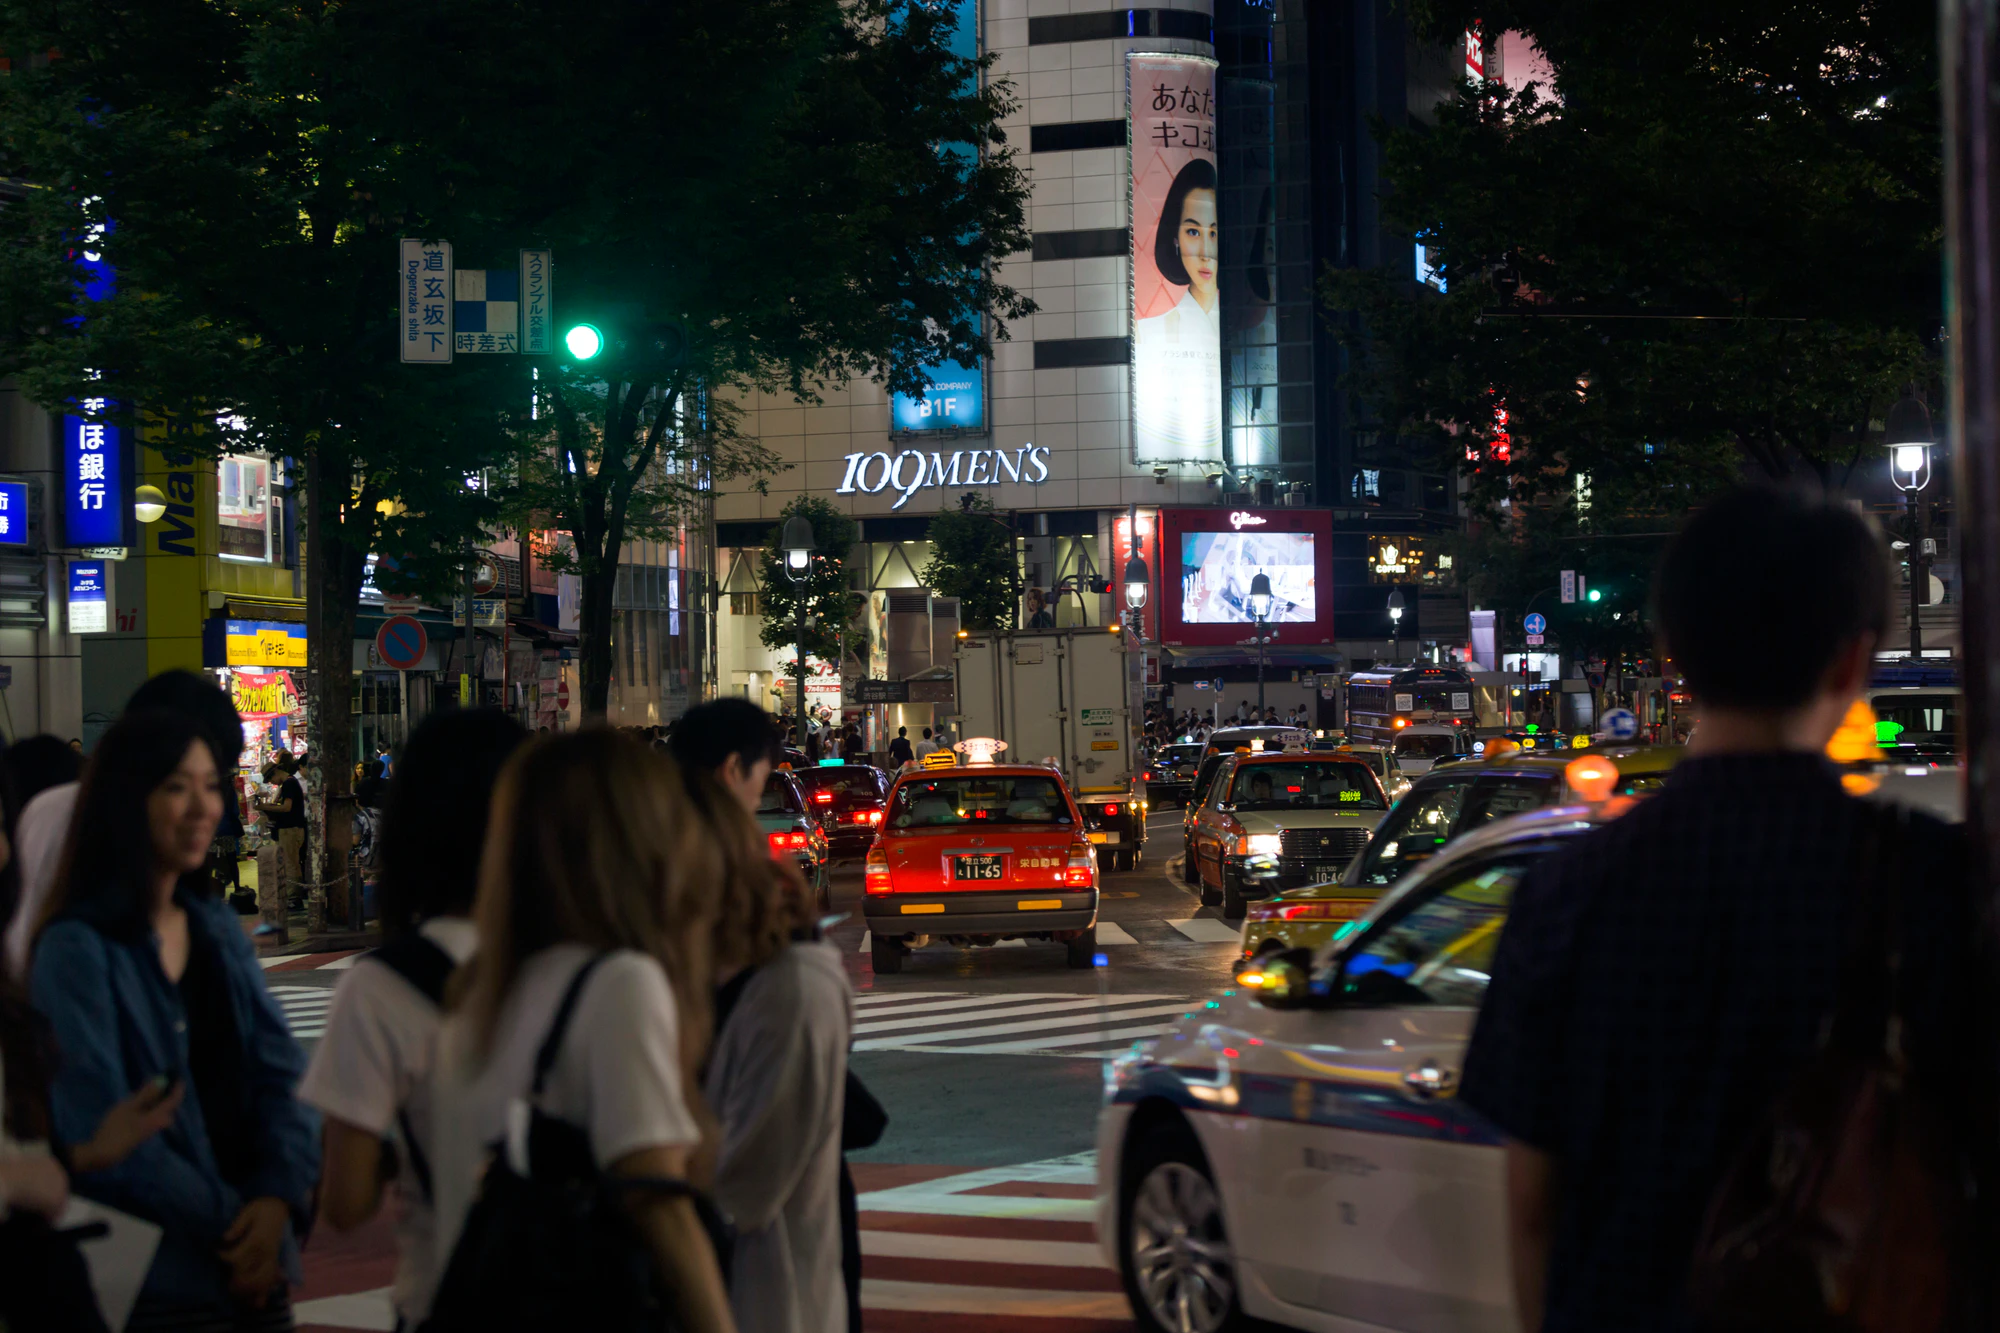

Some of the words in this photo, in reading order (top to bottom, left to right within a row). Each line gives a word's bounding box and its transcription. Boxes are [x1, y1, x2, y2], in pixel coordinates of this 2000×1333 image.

[1152, 83, 1215, 117] あなた
[406, 260, 420, 314] Dogenzaka
[422, 250, 446, 353] 道玄坂下
[529, 253, 545, 349] スクランブル交差点
[408, 318, 420, 342] shita
[457, 333, 516, 352] 時差式
[935, 381, 973, 392] COMPANY
[919, 397, 957, 418] B1F
[1375, 564, 1407, 574] COFFEE
[969, 741, 994, 751] チェッカー
[980, 857, 993, 865] 500
[1020, 857, 1060, 868] 栄自動車
[966, 864, 1001, 879] 11-65
